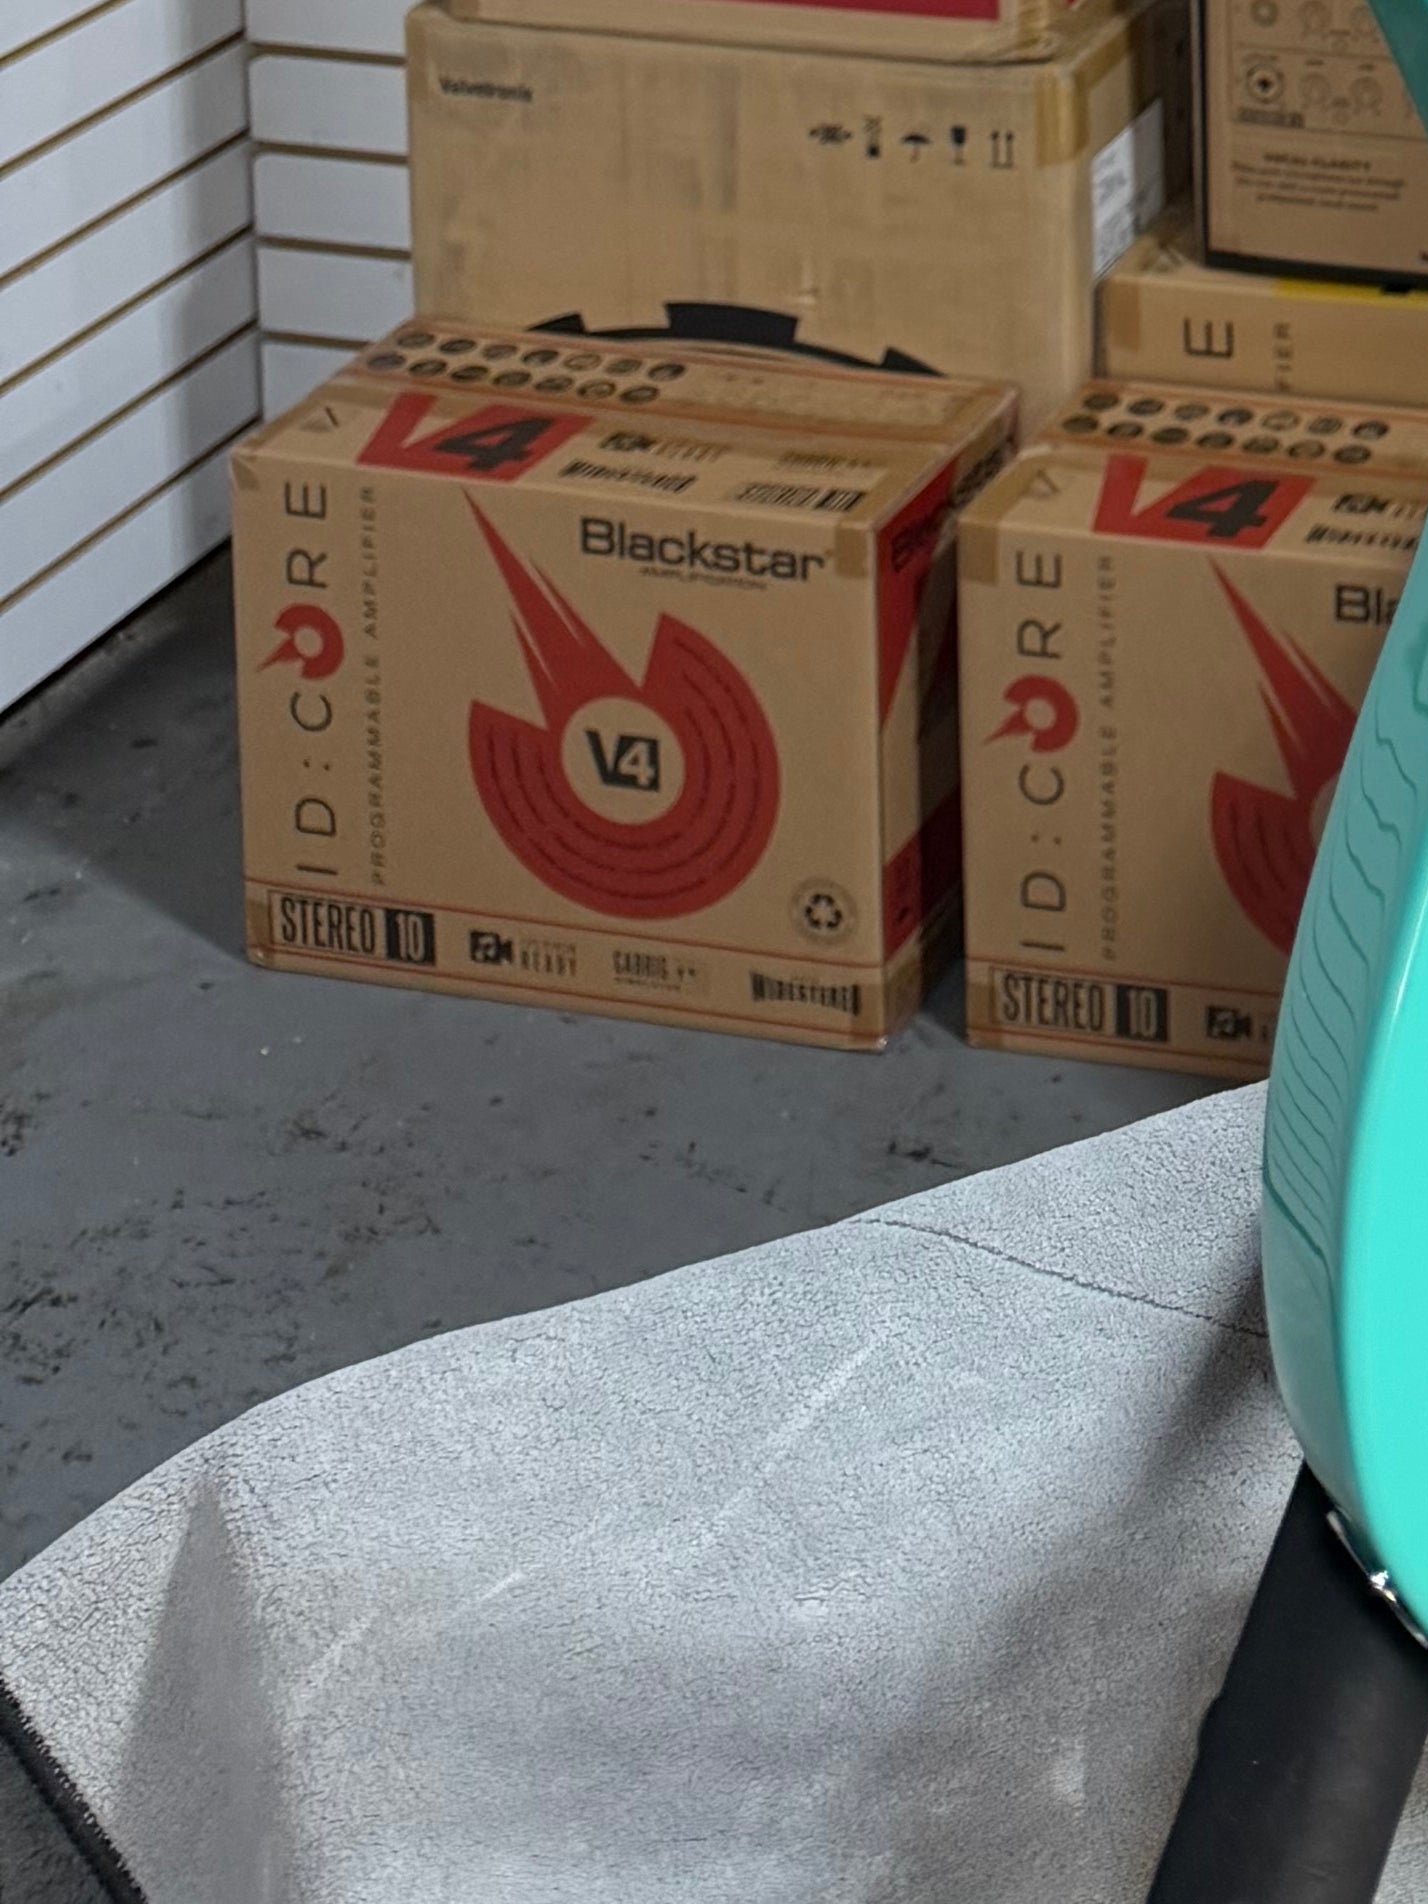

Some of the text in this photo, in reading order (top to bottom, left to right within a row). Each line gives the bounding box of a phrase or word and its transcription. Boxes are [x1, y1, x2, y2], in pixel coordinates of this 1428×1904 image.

[354, 391, 596, 484] V4
[1092, 454, 1316, 550] V4
[580, 515, 826, 583] Blackstar
[585, 726, 661, 793] V4
[280, 896, 377, 955] STEREO
[1002, 972, 1102, 1031] STEREO
